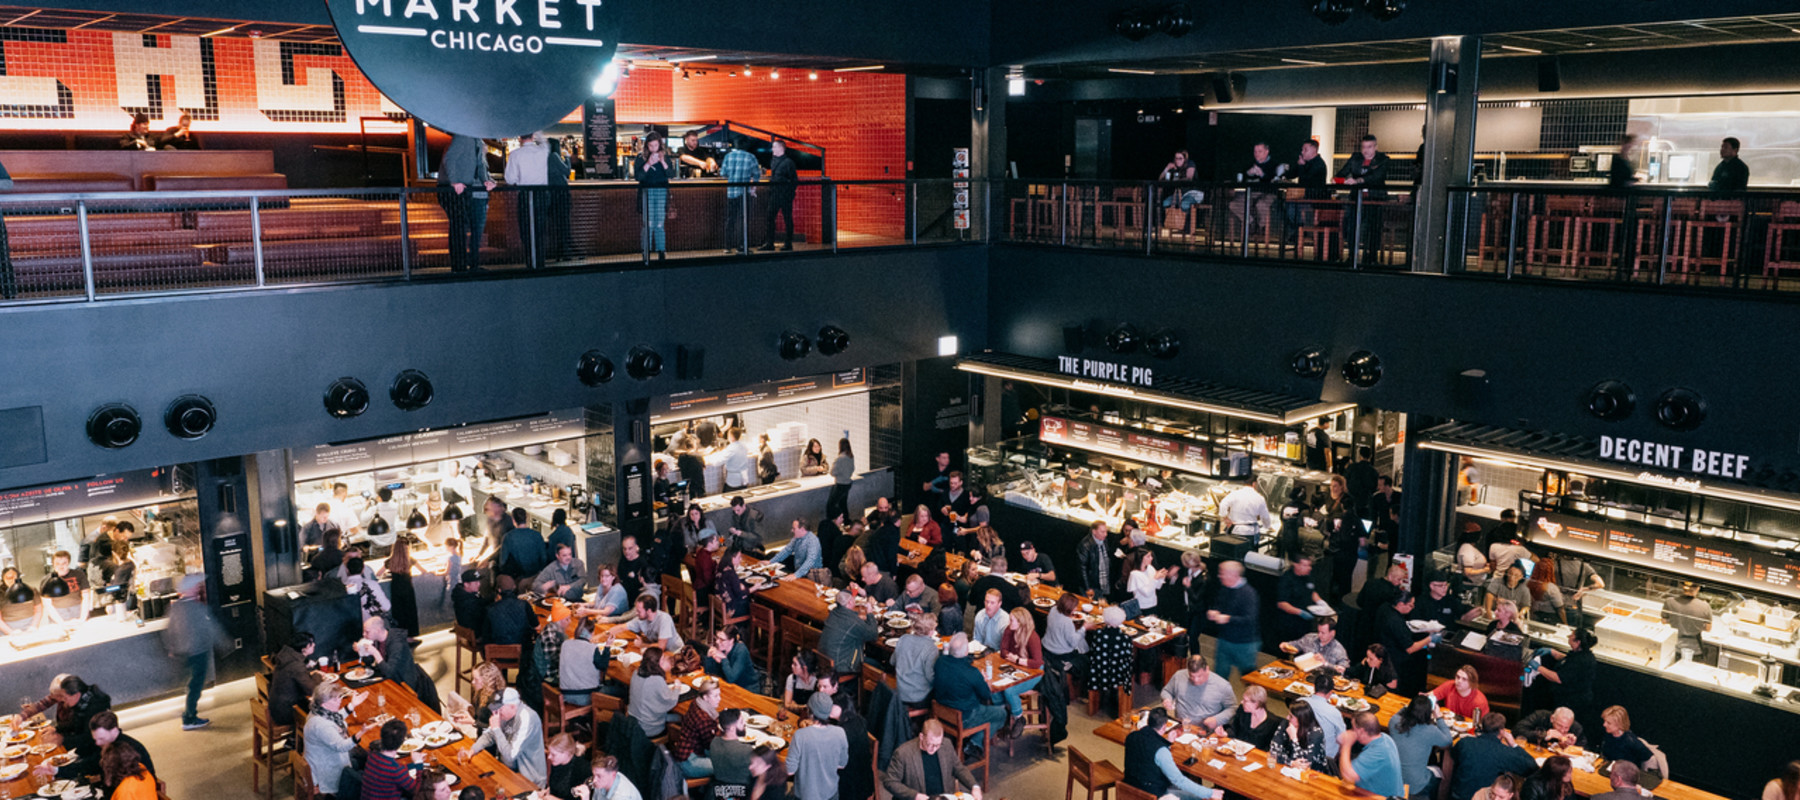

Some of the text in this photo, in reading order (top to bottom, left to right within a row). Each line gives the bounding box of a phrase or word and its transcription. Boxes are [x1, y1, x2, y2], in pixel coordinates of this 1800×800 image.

[431, 29, 543, 54] CHICAGO
[1058, 355, 1153, 386] THE PURPLE PIG
[1600, 434, 1750, 479] DECENT BEEF
[86, 478, 114, 488] FOLLOW
